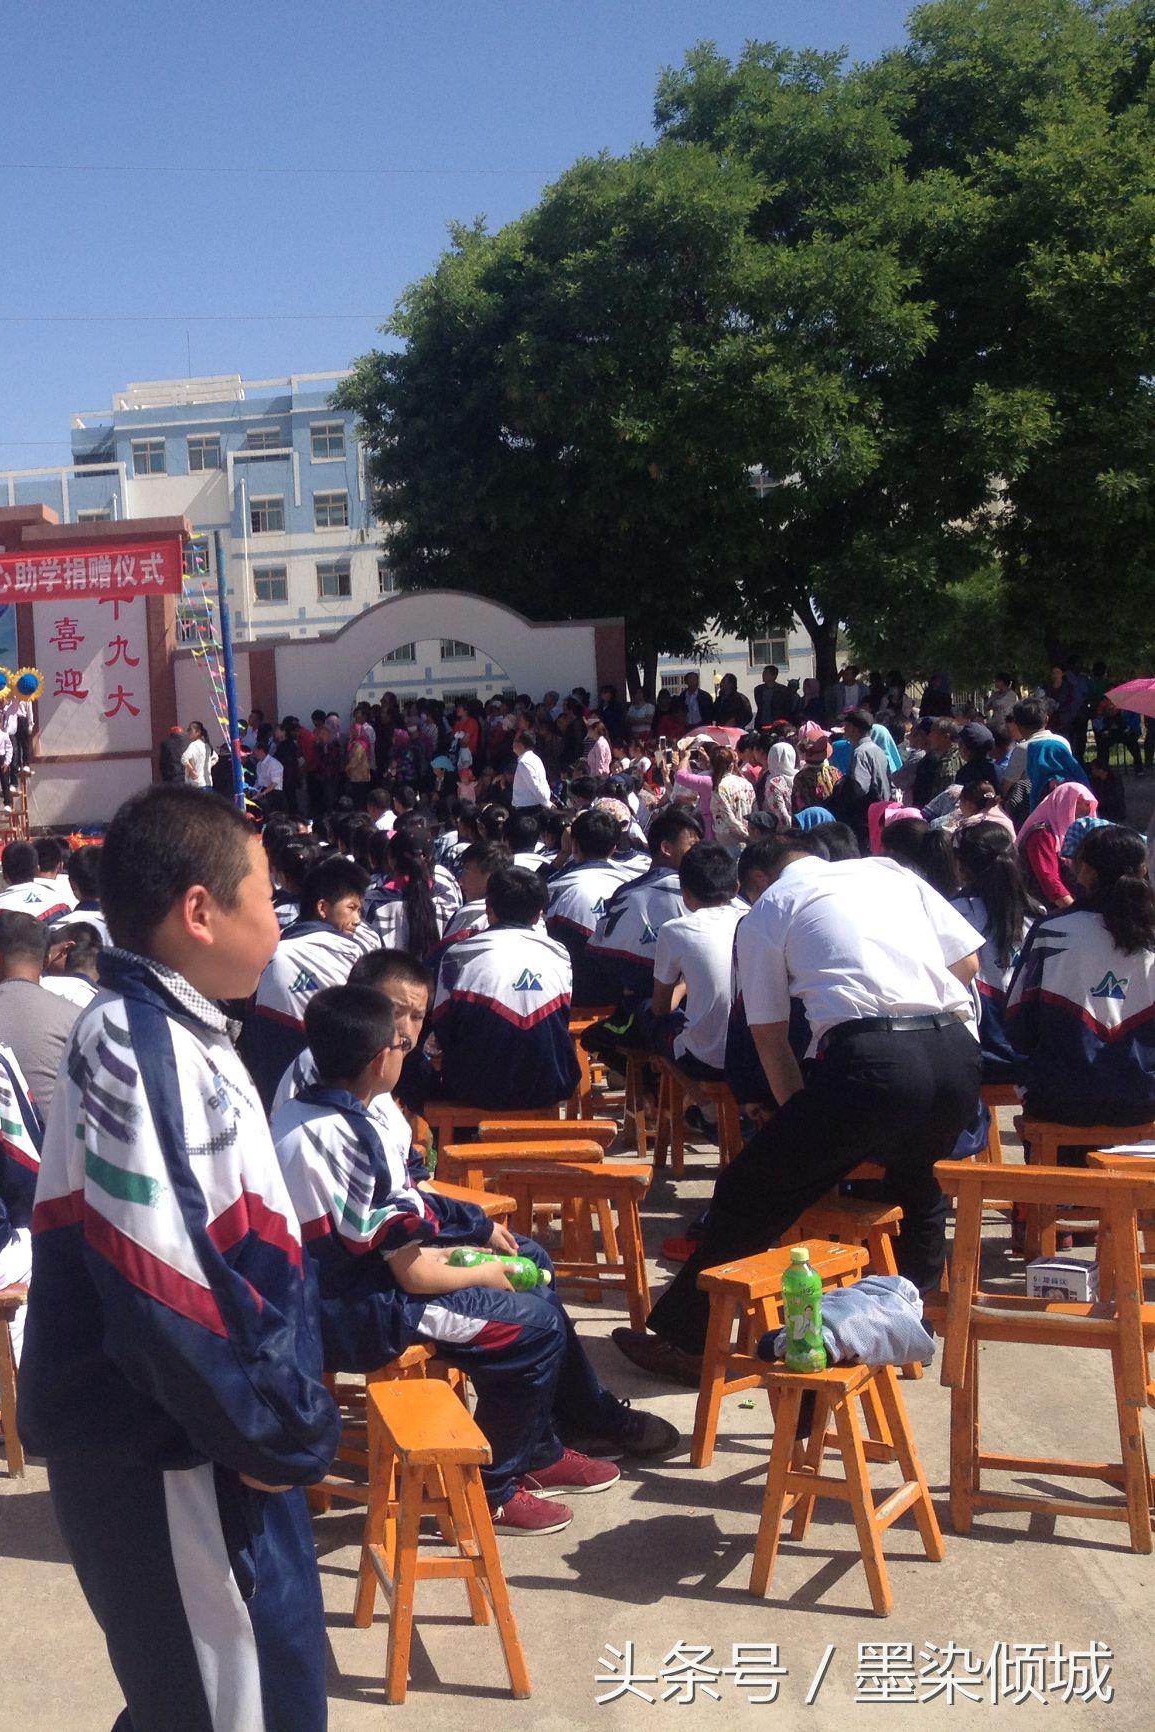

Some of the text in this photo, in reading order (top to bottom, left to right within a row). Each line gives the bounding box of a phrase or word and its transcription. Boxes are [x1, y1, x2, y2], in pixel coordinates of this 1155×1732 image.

[49, 617, 89, 704] 喜迎
[98, 595, 141, 717] 十九大
